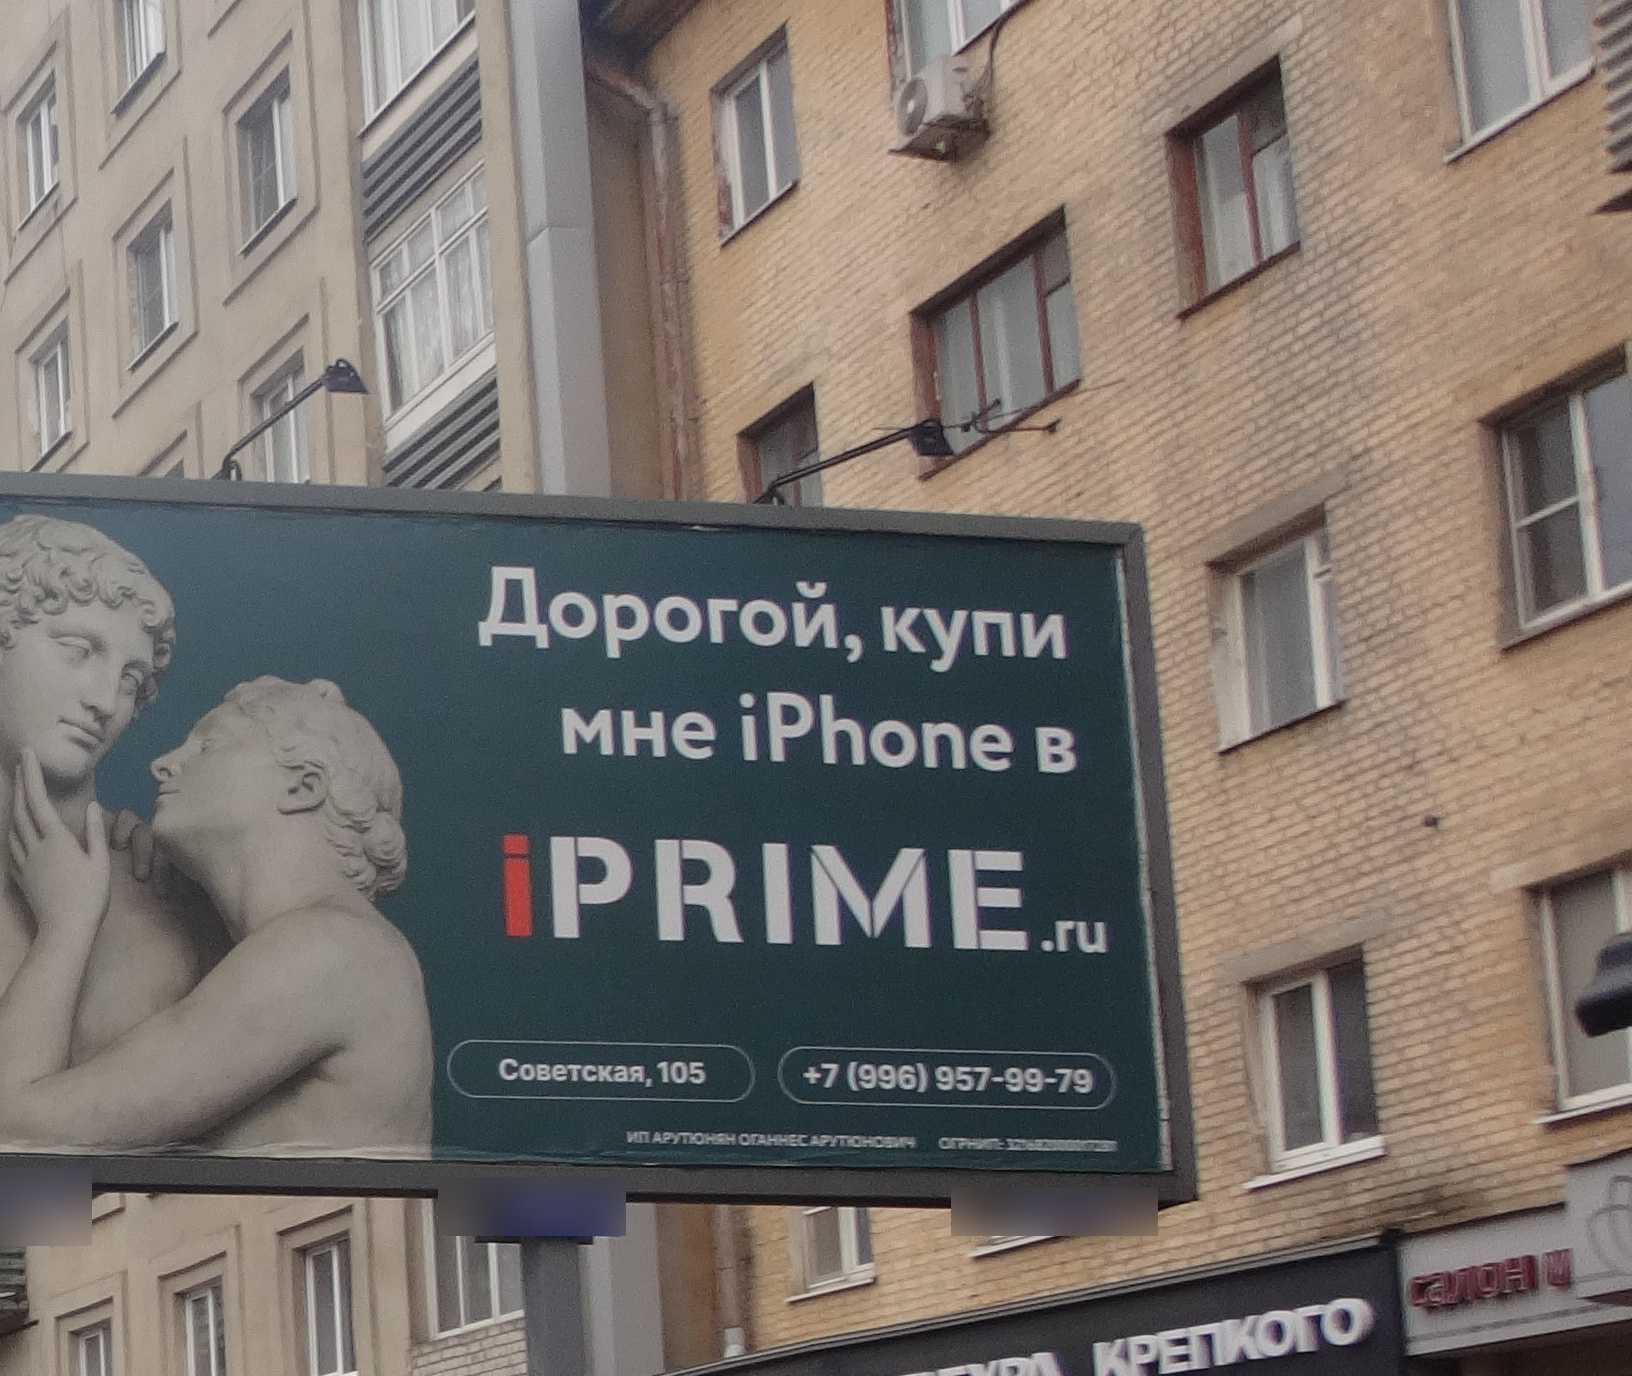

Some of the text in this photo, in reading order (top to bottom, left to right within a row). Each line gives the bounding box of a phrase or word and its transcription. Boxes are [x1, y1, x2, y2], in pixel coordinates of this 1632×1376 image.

[478, 565, 1068, 672] Дорогой, купи
[561, 692, 1077, 774] мне iPhone в
[498, 1058, 706, 1089] Советская, 105
[802, 1062, 1094, 1095] +7 (996) 957-99-79
[1409, 1255, 1538, 1309] салон
